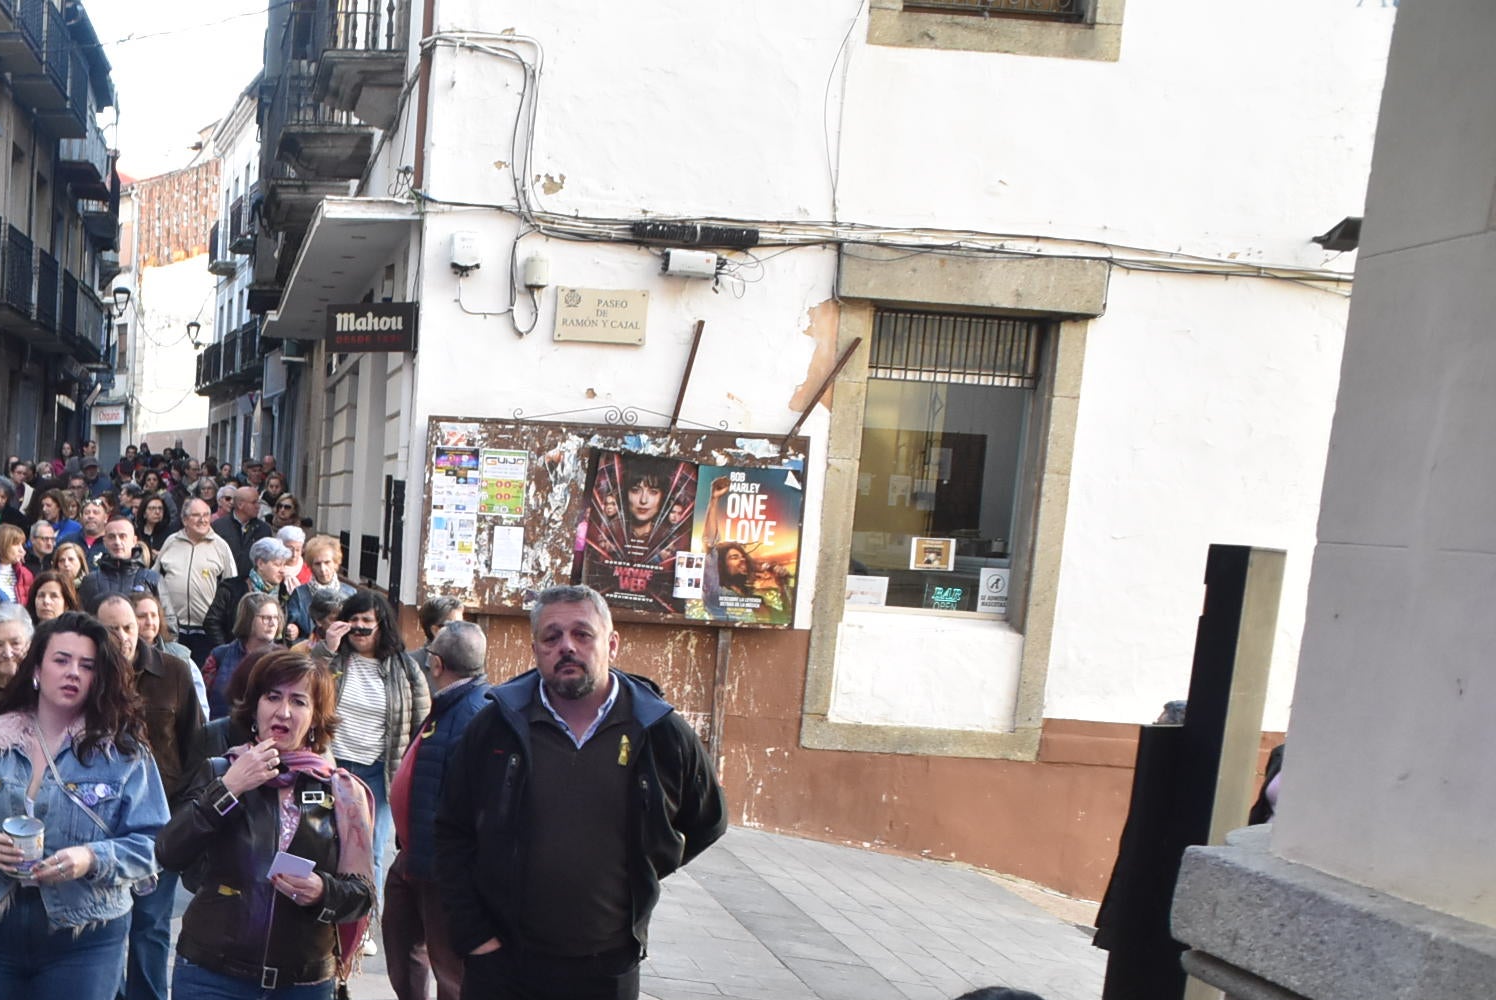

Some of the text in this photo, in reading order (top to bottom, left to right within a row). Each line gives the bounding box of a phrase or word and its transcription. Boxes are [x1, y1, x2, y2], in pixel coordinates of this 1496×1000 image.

[597, 298, 628, 308] PASEO
[596, 308, 608, 317] DE
[335, 311, 403, 332] Mahou
[561, 315, 640, 330] RAMÓN Y CAJAL
[336, 334, 371, 344] DESDE
[729, 471, 746, 482] BOB
[728, 482, 760, 494] MARLEY
[726, 493, 768, 520] ONE
[724, 518, 777, 546] LOVE
[619, 577, 648, 591] WEB
[932, 586, 963, 602] BAR
[933, 601, 957, 611] OPEN
